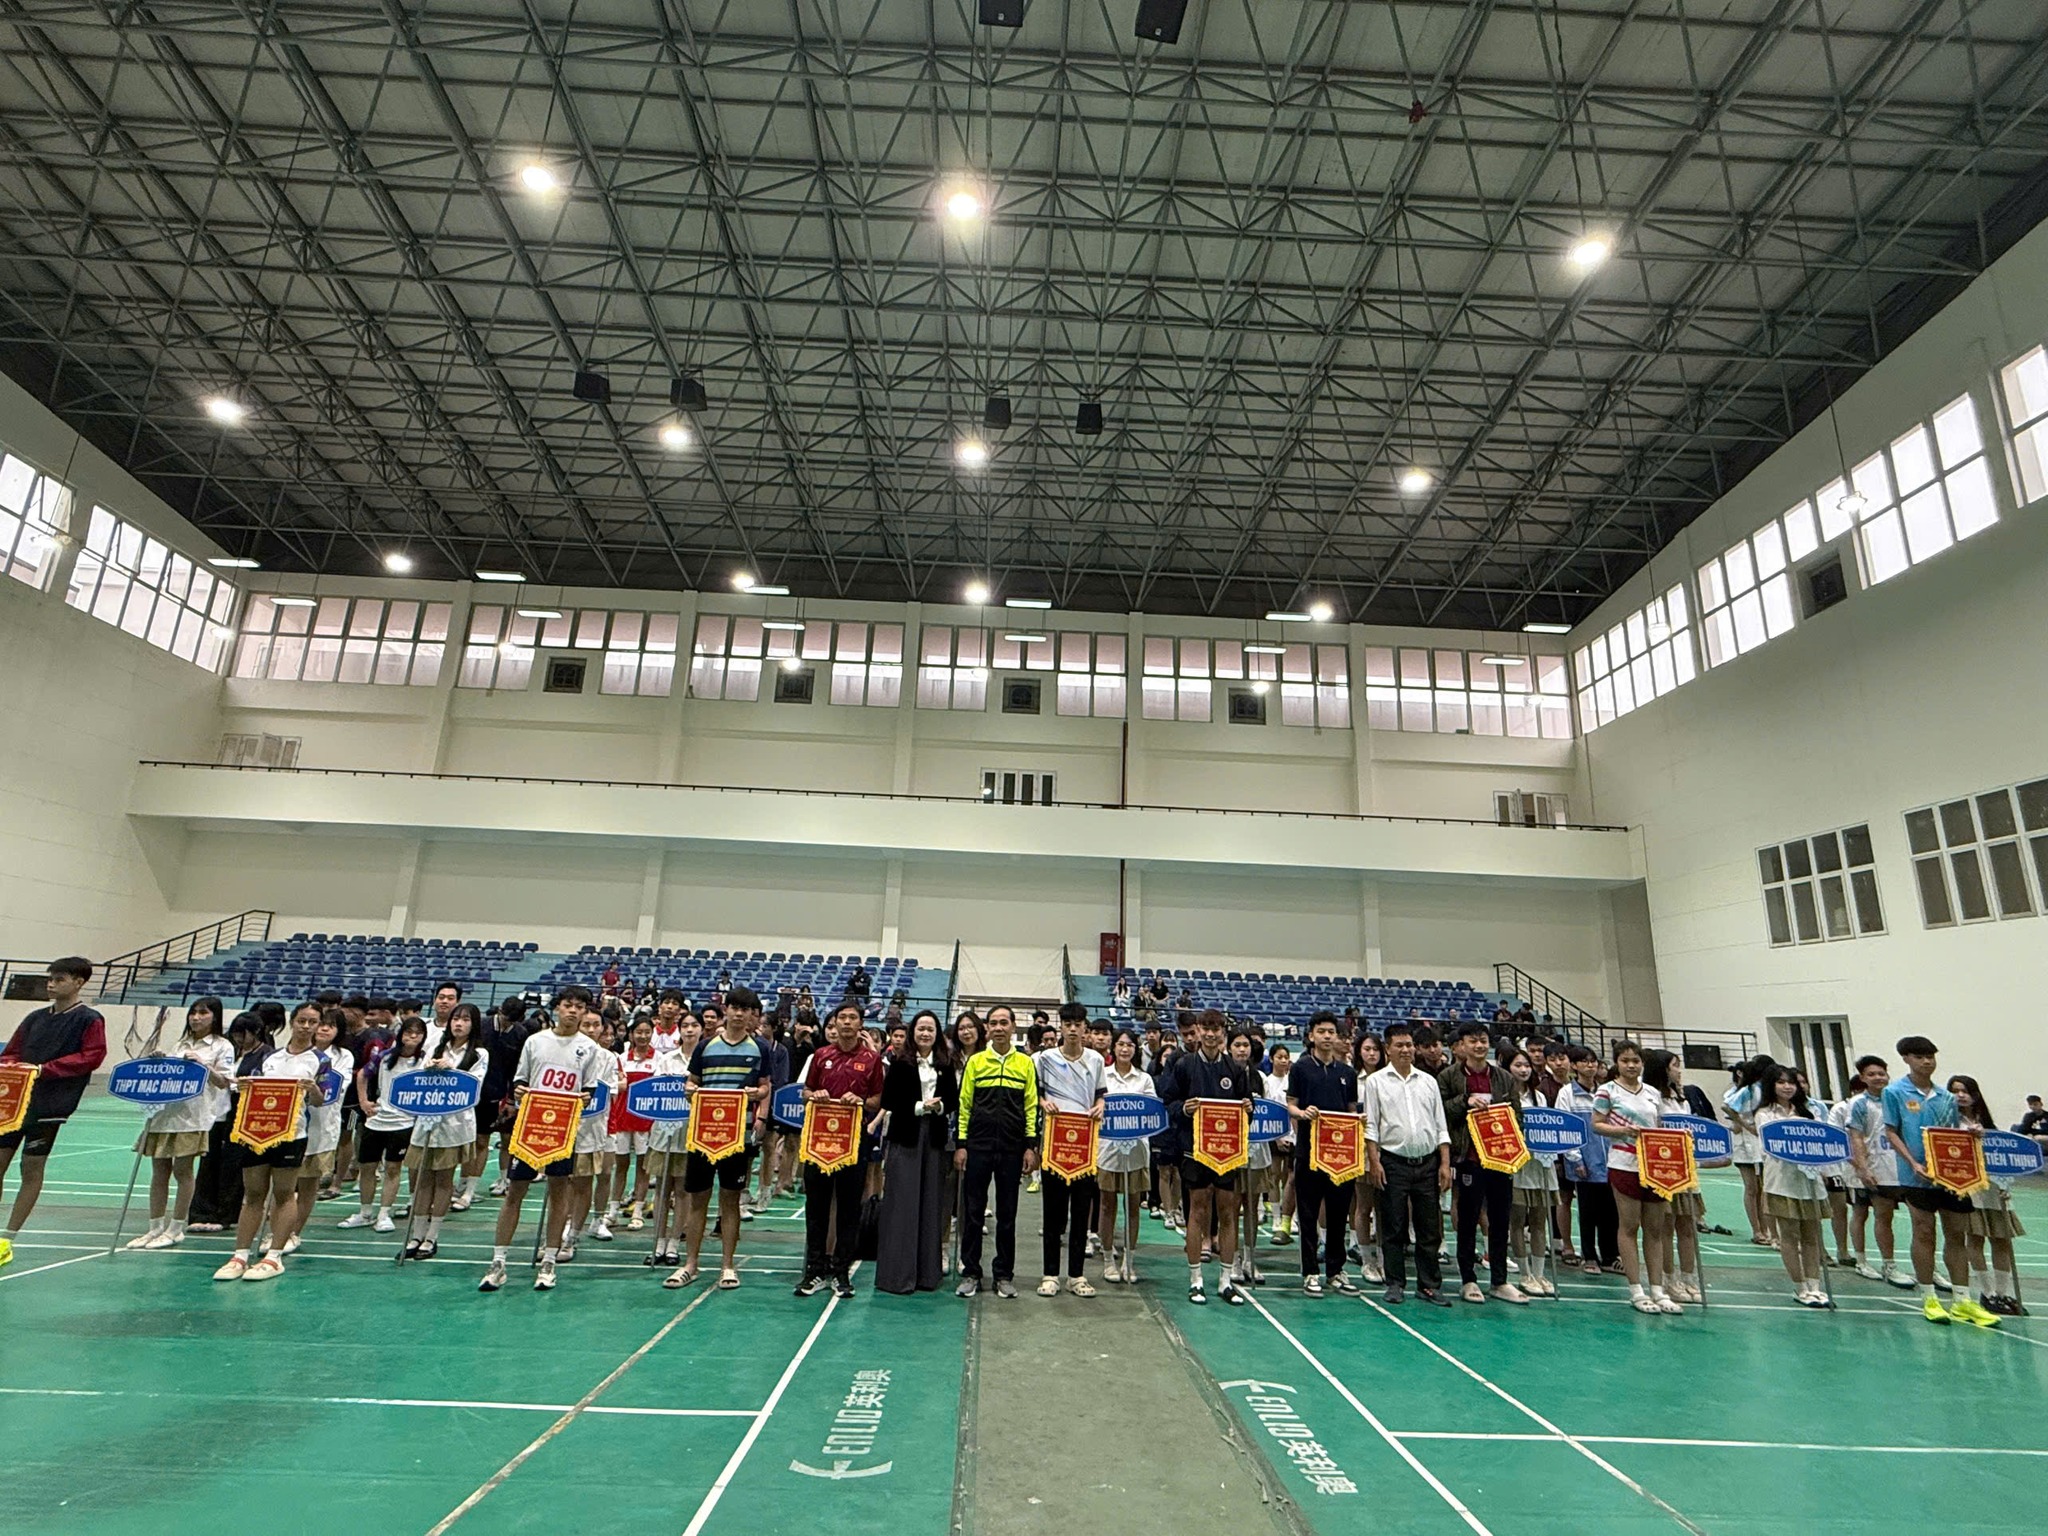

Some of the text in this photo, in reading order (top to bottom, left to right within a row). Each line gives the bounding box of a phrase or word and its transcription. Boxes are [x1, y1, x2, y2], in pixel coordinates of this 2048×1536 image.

[138, 1062, 185, 1075] TRƯỜNG
[115, 1079, 138, 1093] THPT
[138, 1079, 160, 1097] MẠC
[183, 1080, 199, 1095] CHI
[414, 1074, 458, 1087] TRƯỜNG
[542, 1068, 577, 1092] 039
[398, 1088, 470, 1106] THPT SÓC SƠN
[635, 1097, 659, 1111] THPT
[782, 1103, 805, 1118] THP
[1101, 1116, 1111, 1130] PT
[1113, 1115, 1139, 1130] MINH
[1140, 1112, 1161, 1129] PHÚ
[1262, 1119, 1284, 1134] ANH
[1529, 1128, 1557, 1144] QUANG
[1558, 1130, 1582, 1145] MINH
[1782, 1124, 1826, 1138] TRƯỜNG
[1697, 1138, 1726, 1154] GIANG
[1768, 1139, 1787, 1154] THPT
[1788, 1140, 1803, 1157] LẠC
[1803, 1141, 1824, 1157] LONG
[1985, 1148, 2038, 1171] TIẾN THỊNH
